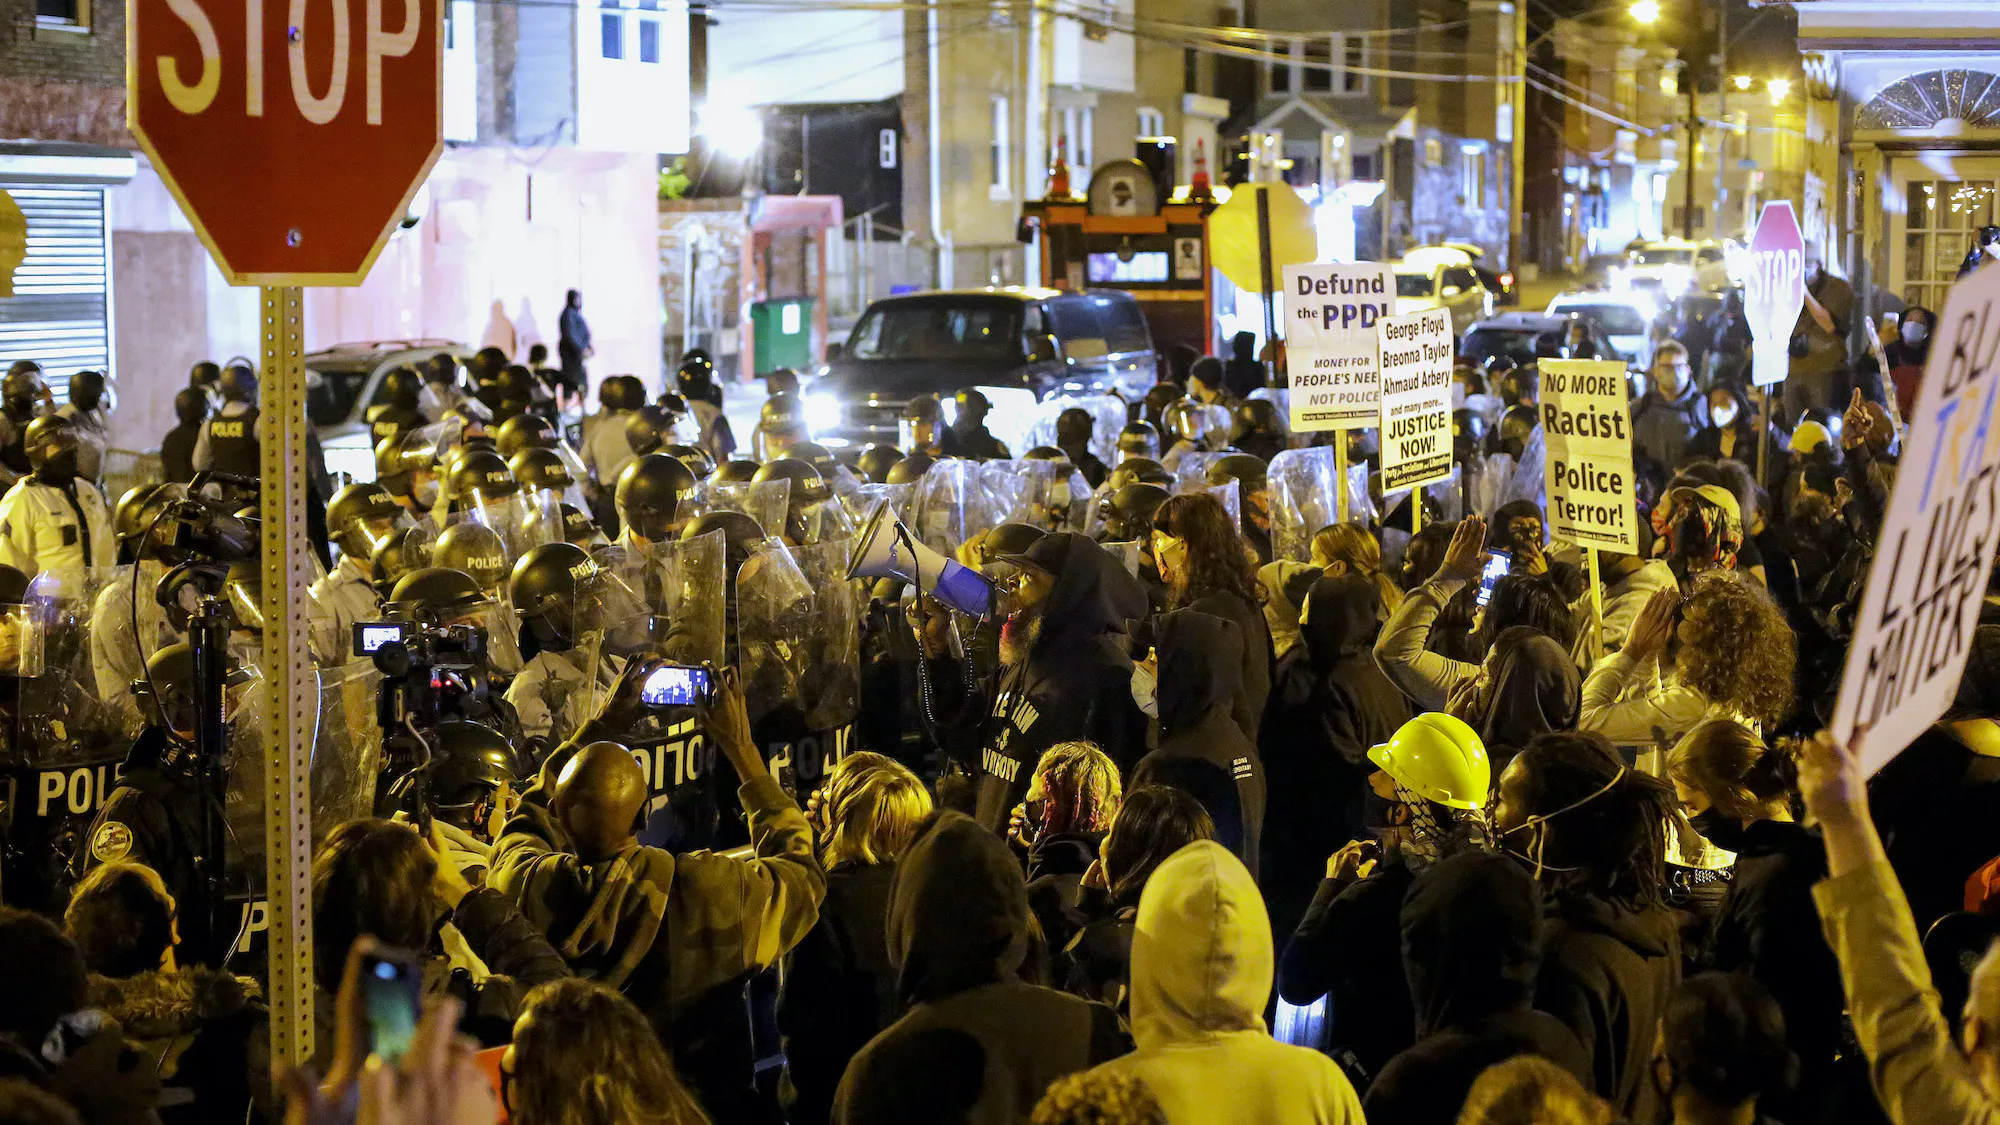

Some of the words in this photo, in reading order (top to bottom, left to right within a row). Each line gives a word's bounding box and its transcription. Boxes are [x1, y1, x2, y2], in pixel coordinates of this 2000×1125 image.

[1297, 272, 1385, 296] Defund
[1751, 249, 1801, 303] STOP
[1297, 307, 1318, 319] the
[1386, 322, 1419, 341] George
[1421, 314, 1445, 337] Floyd
[1314, 358, 1349, 368] MONEY
[1351, 357, 1370, 367] FOR
[1383, 349, 1420, 368] Breonna
[1422, 341, 1450, 363] Taylor
[1295, 373, 1350, 387] PEOPLE'S
[1354, 372, 1378, 384] NEE
[1383, 372, 1419, 396] Ahmaud
[1422, 369, 1450, 388] Arbery
[1545, 373, 1566, 393] NO
[1571, 375, 1616, 396] MORE
[1309, 393, 1335, 405] NOT
[1338, 390, 1380, 404] POLICE
[1391, 404, 1403, 416] and
[1404, 402, 1421, 413] many
[210, 421, 244, 438] POLICE
[1389, 411, 1445, 440] JUSTICE
[1544, 403, 1625, 440] Racist
[1400, 435, 1436, 459] NOW!
[1554, 460, 1622, 495] Police
[1554, 495, 1624, 528] Terror!
[467, 555, 503, 570] POLICE
